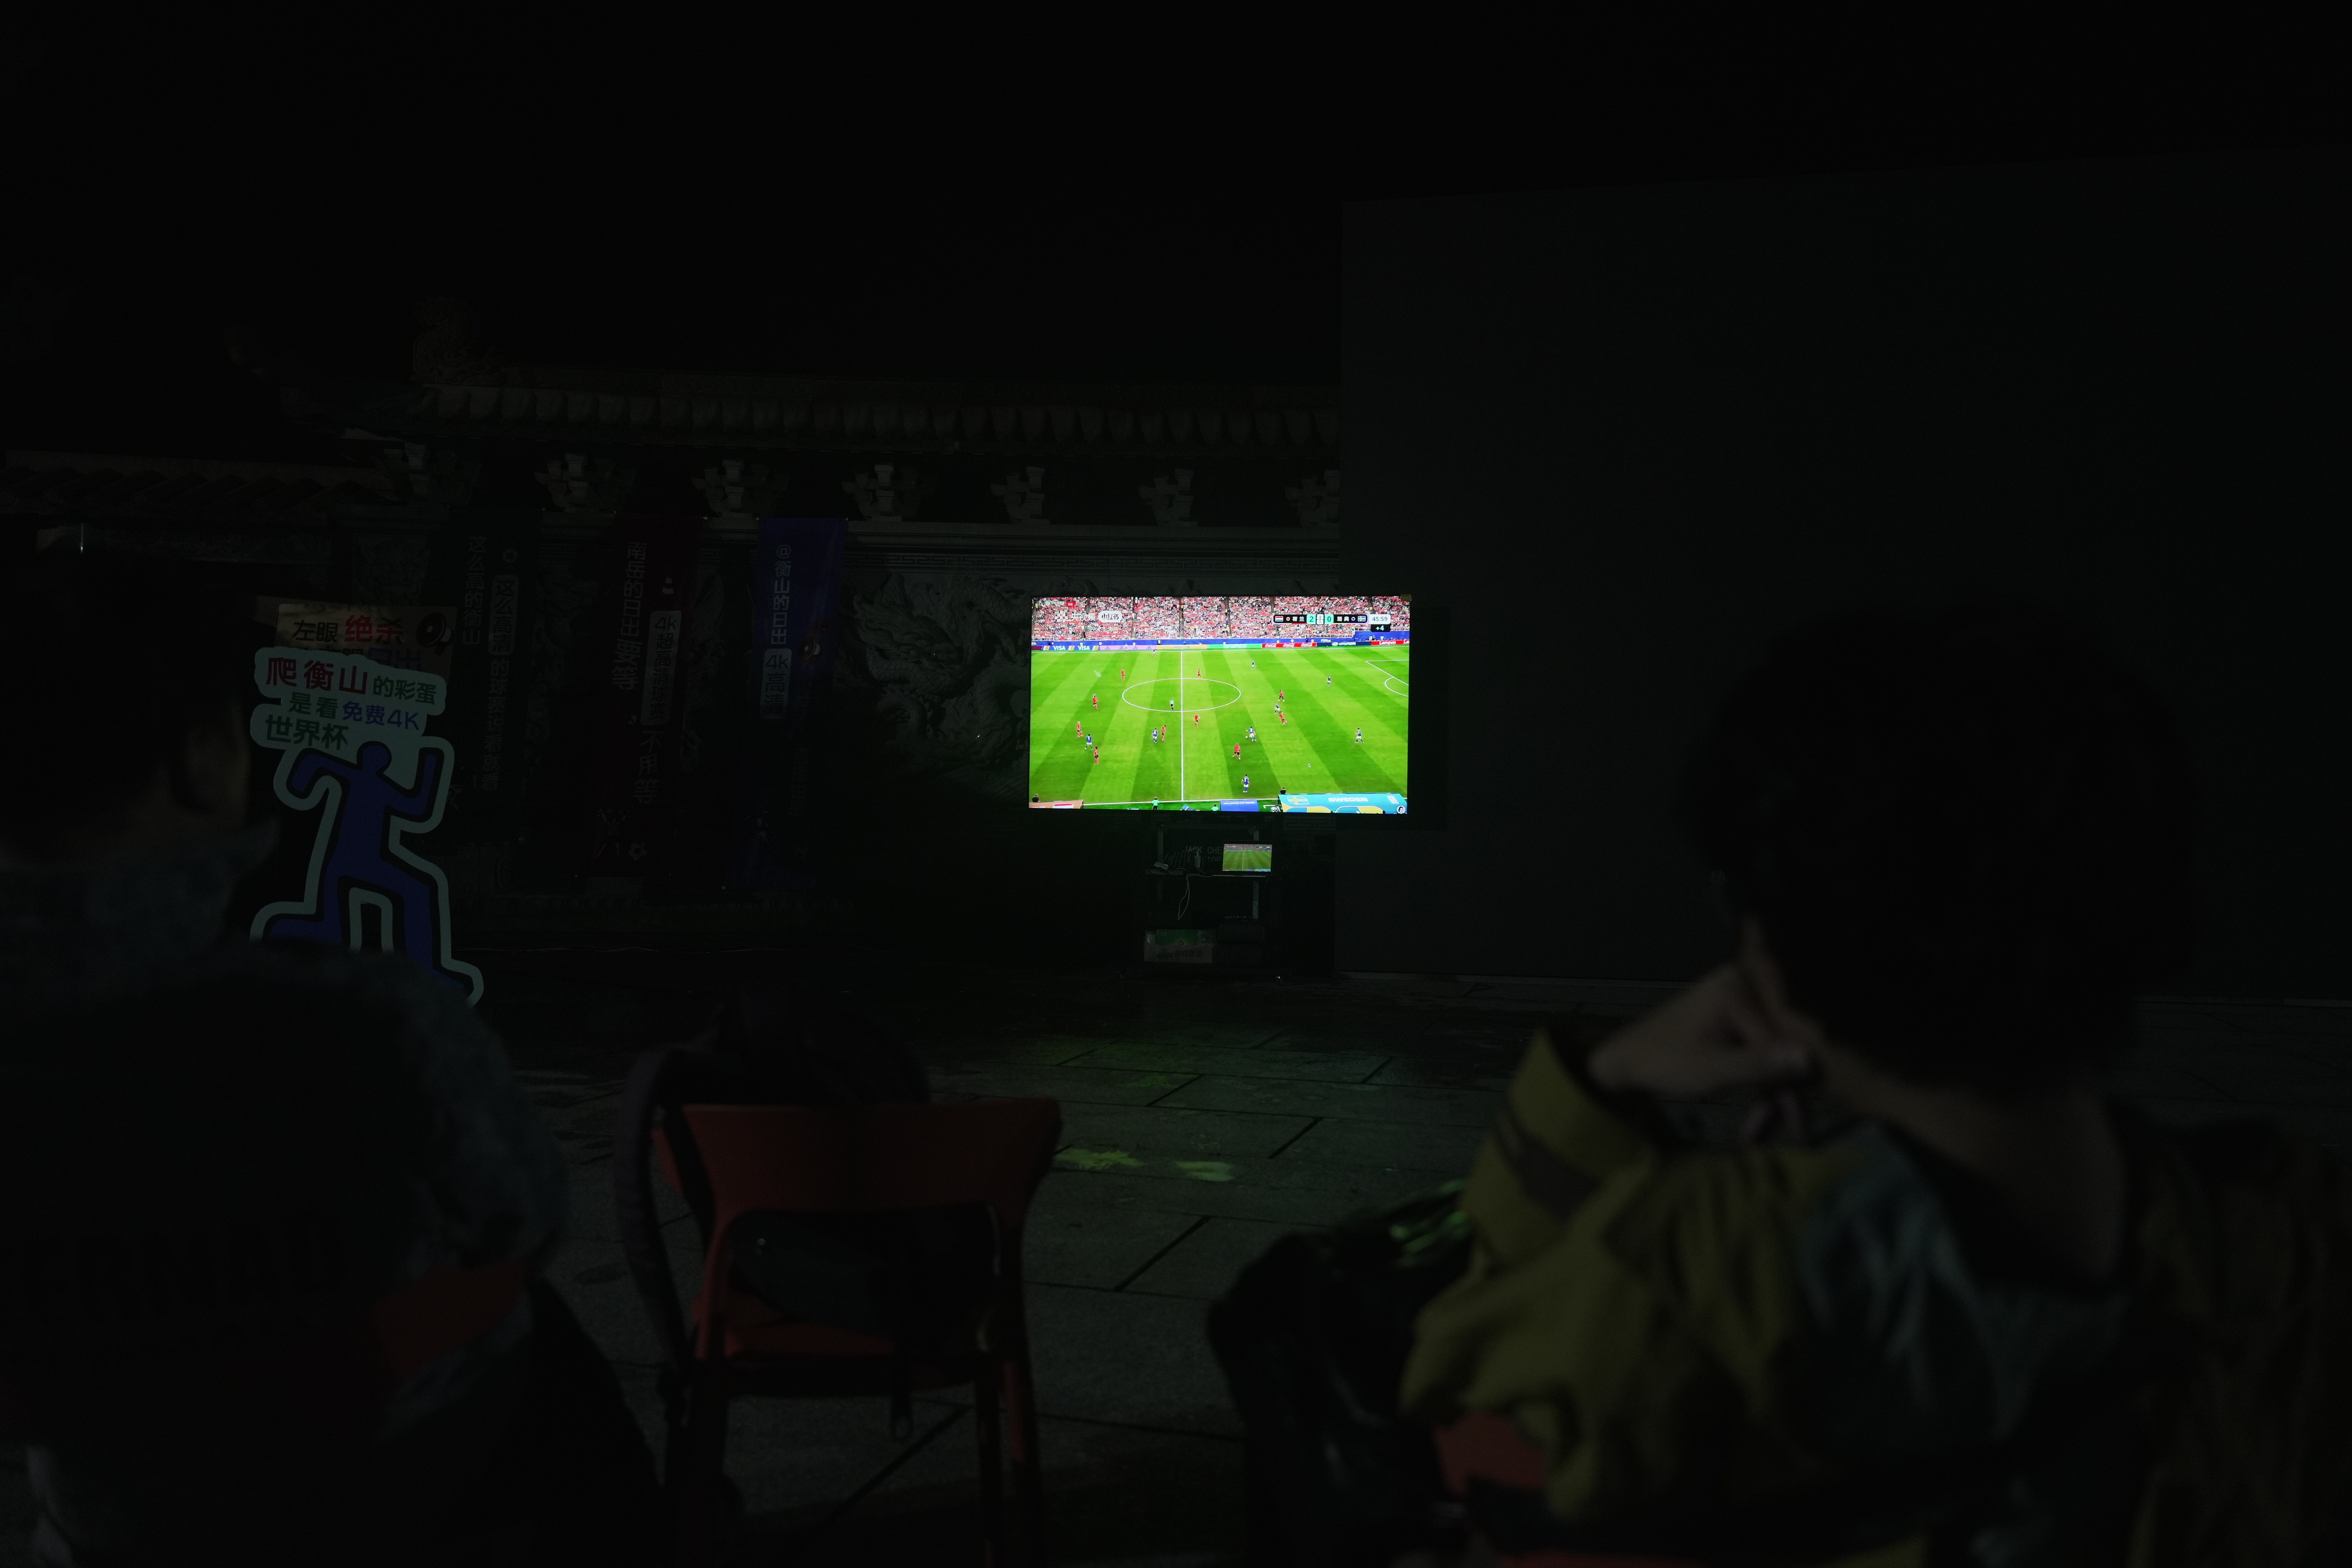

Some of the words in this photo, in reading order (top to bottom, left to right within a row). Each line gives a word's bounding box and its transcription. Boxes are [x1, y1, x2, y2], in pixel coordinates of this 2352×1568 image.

[292, 615, 404, 645] 左眼绝杀
[612, 541, 647, 690] 南岳的日出要等
[265, 657, 436, 705] 爬衡山的彩蛋
[265, 714, 350, 750] 世界杯
